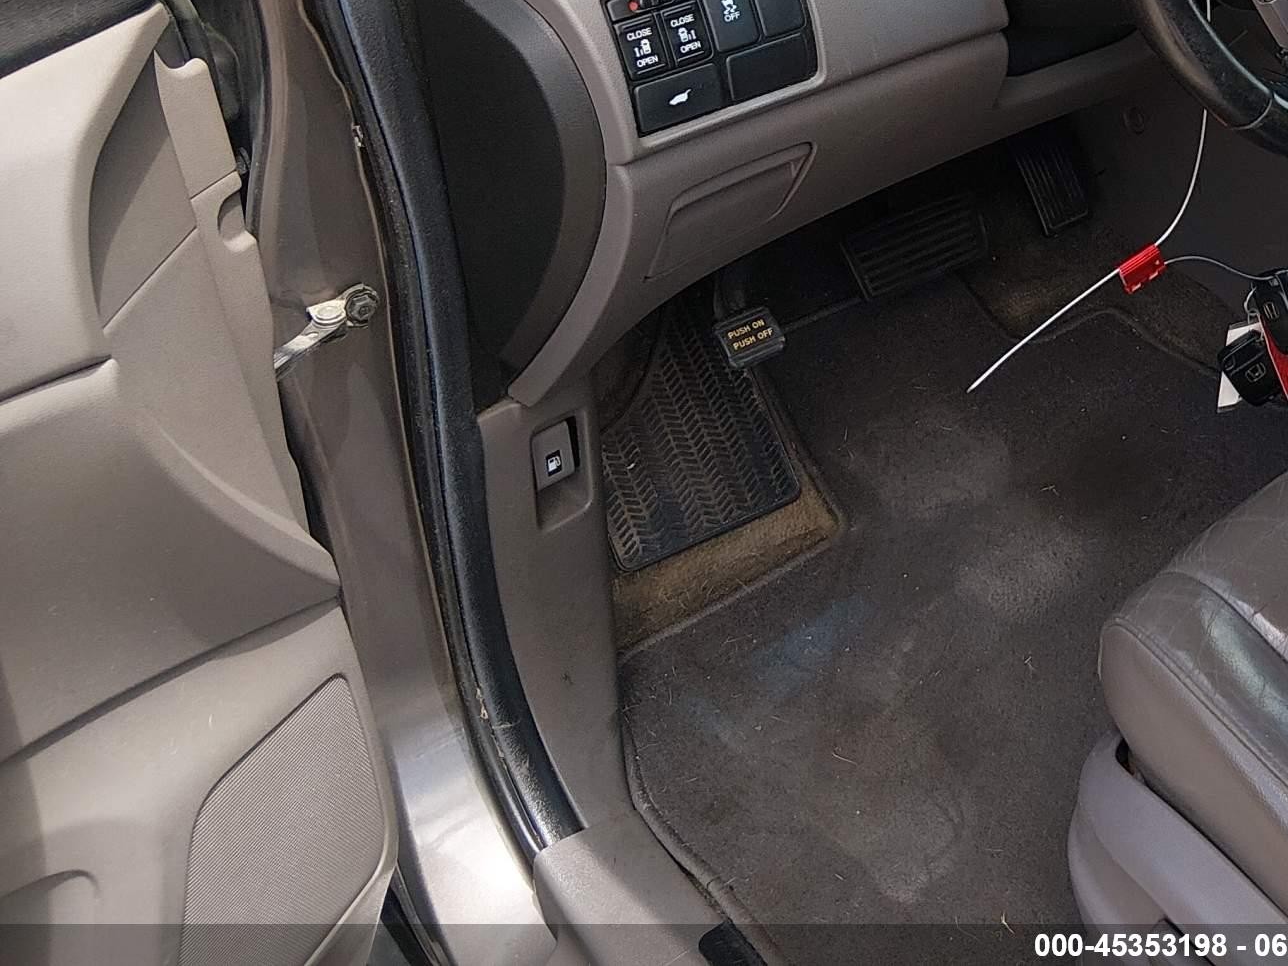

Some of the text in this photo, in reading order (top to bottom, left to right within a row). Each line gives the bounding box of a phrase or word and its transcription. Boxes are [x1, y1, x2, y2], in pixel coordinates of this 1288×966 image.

[670, 14, 695, 28] CLOSE
[724, 11, 741, 23] OFF
[626, 27, 653, 41] CLOSE
[680, 40, 702, 53] OPEN
[636, 54, 659, 68] OPEN
[727, 319, 765, 340] PUSH ON
[732, 327, 774, 351] PUSH OFF
